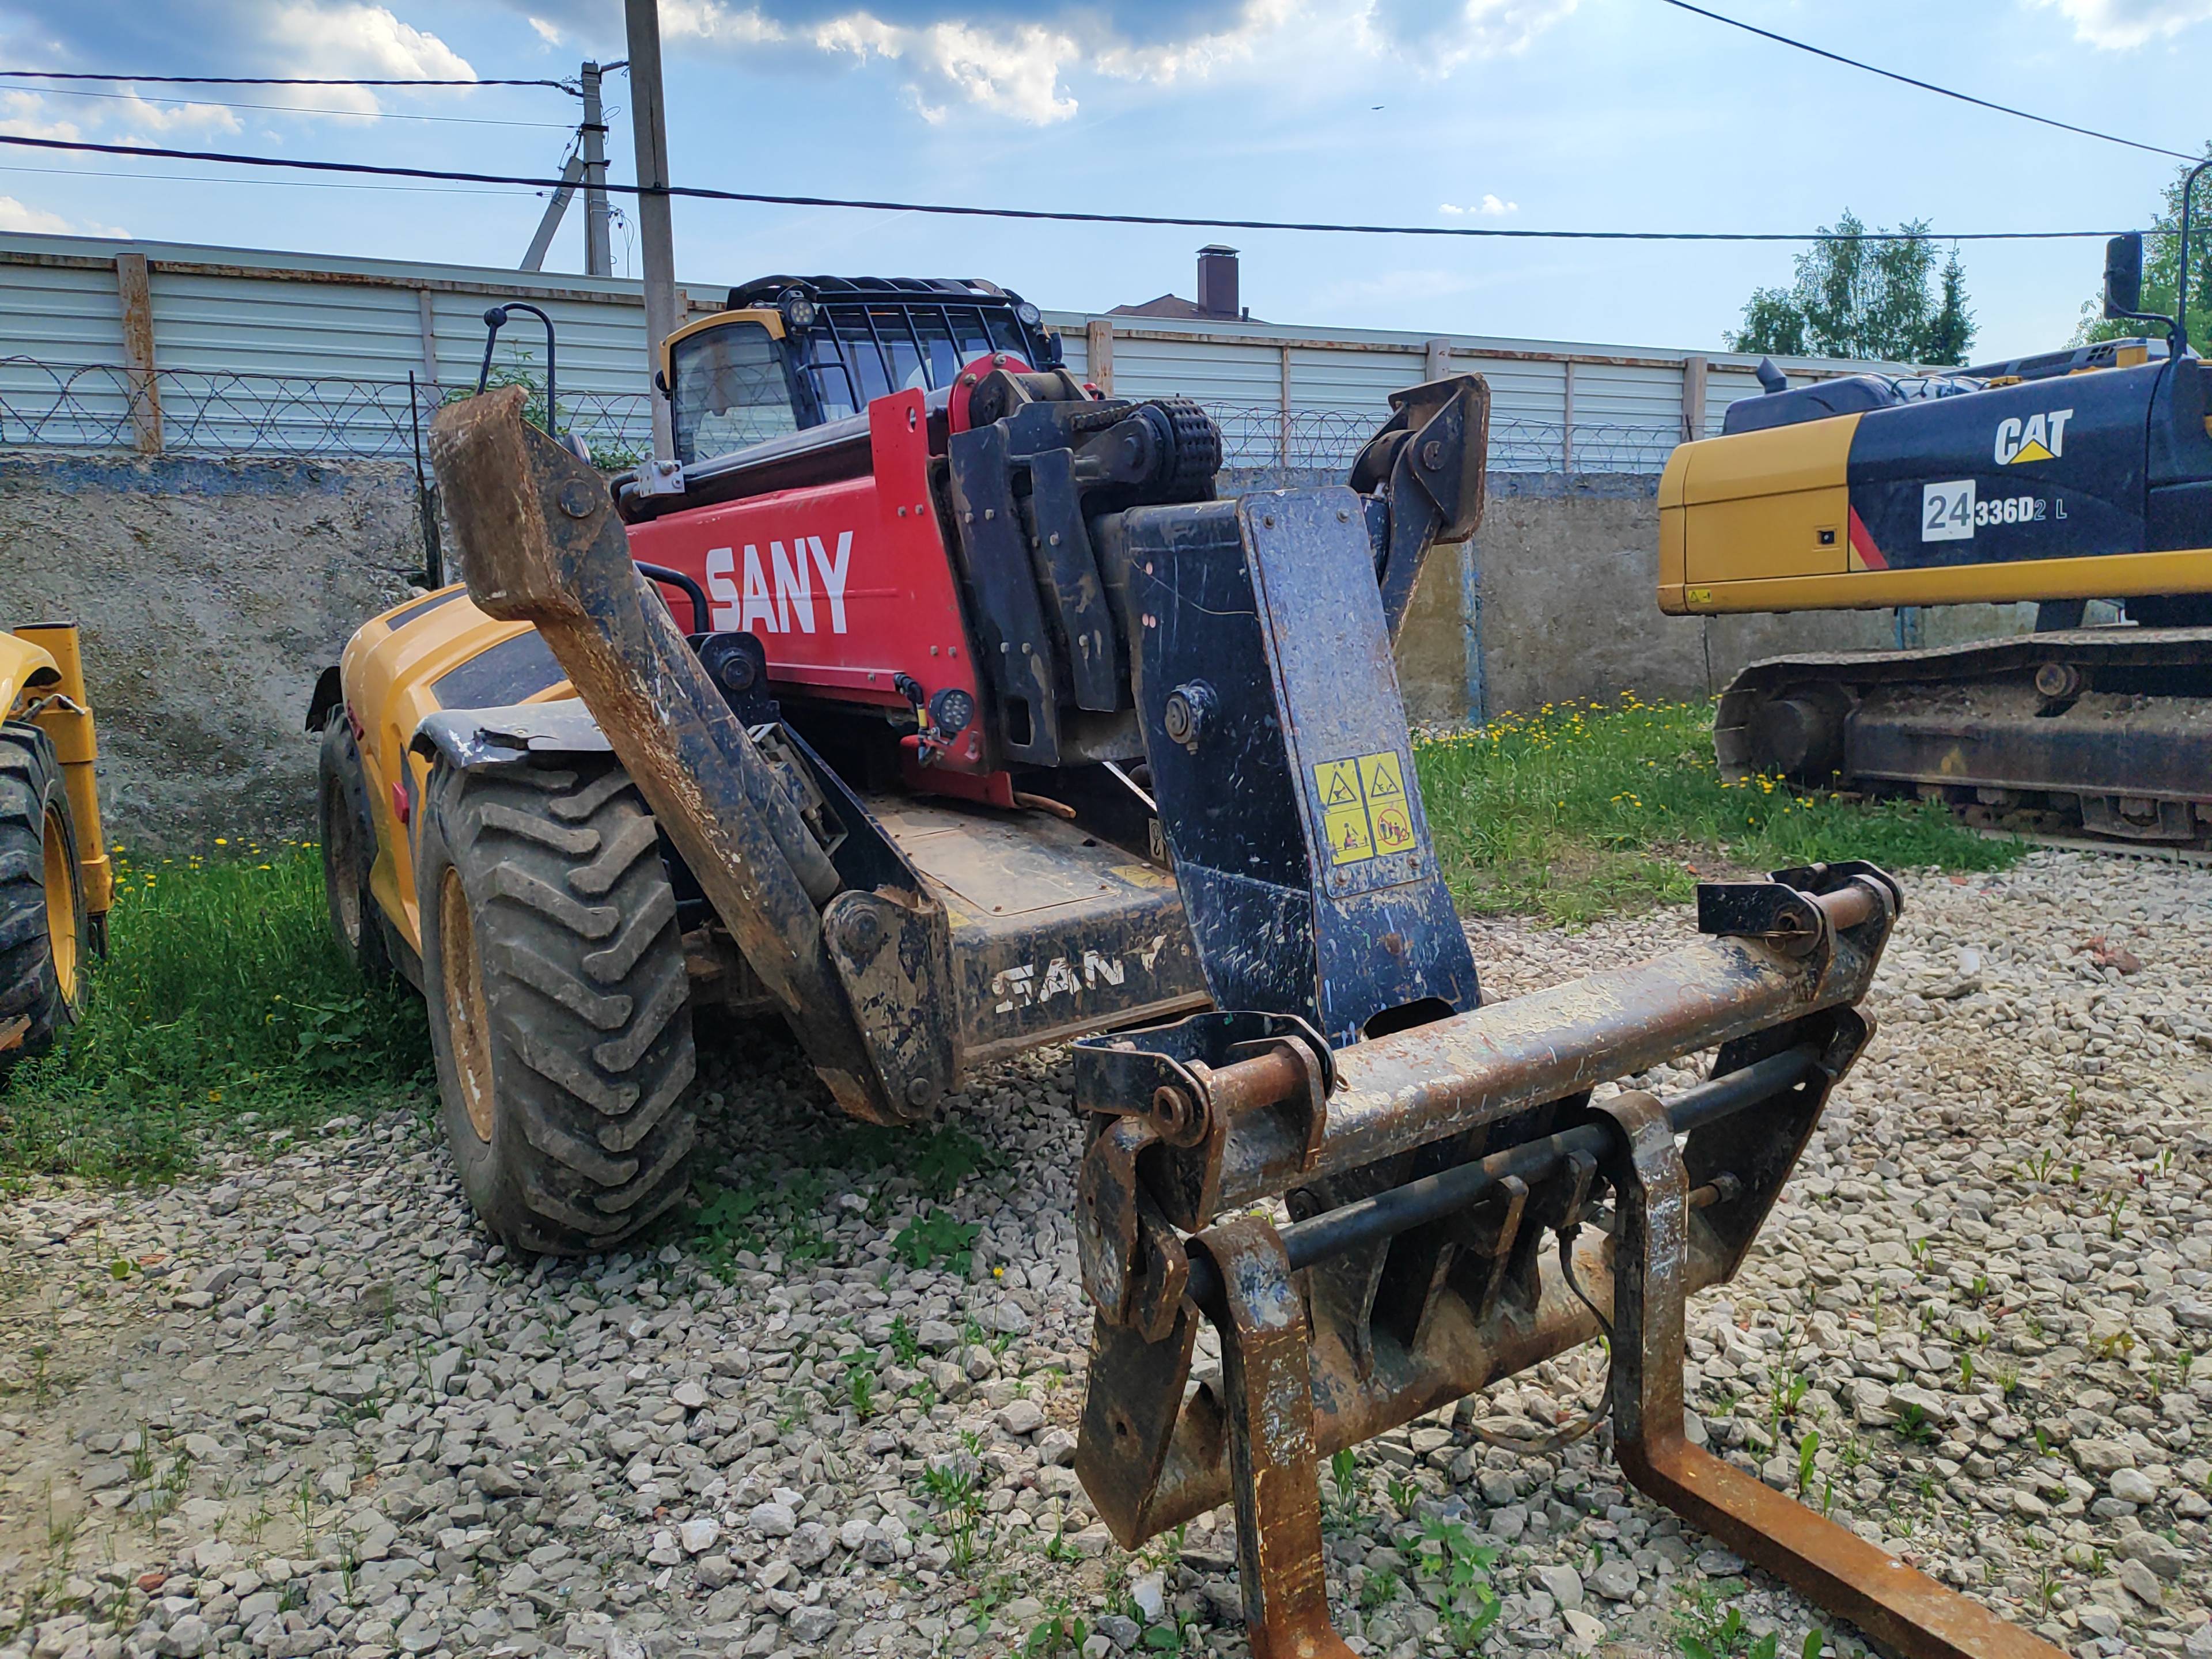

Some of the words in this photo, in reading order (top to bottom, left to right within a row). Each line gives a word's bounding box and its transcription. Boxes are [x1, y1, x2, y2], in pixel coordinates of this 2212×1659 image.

[1994, 409, 2073, 465] CAT
[1926, 492, 1971, 529] 24
[2056, 499, 2067, 519] L
[706, 531, 853, 634] SANY
